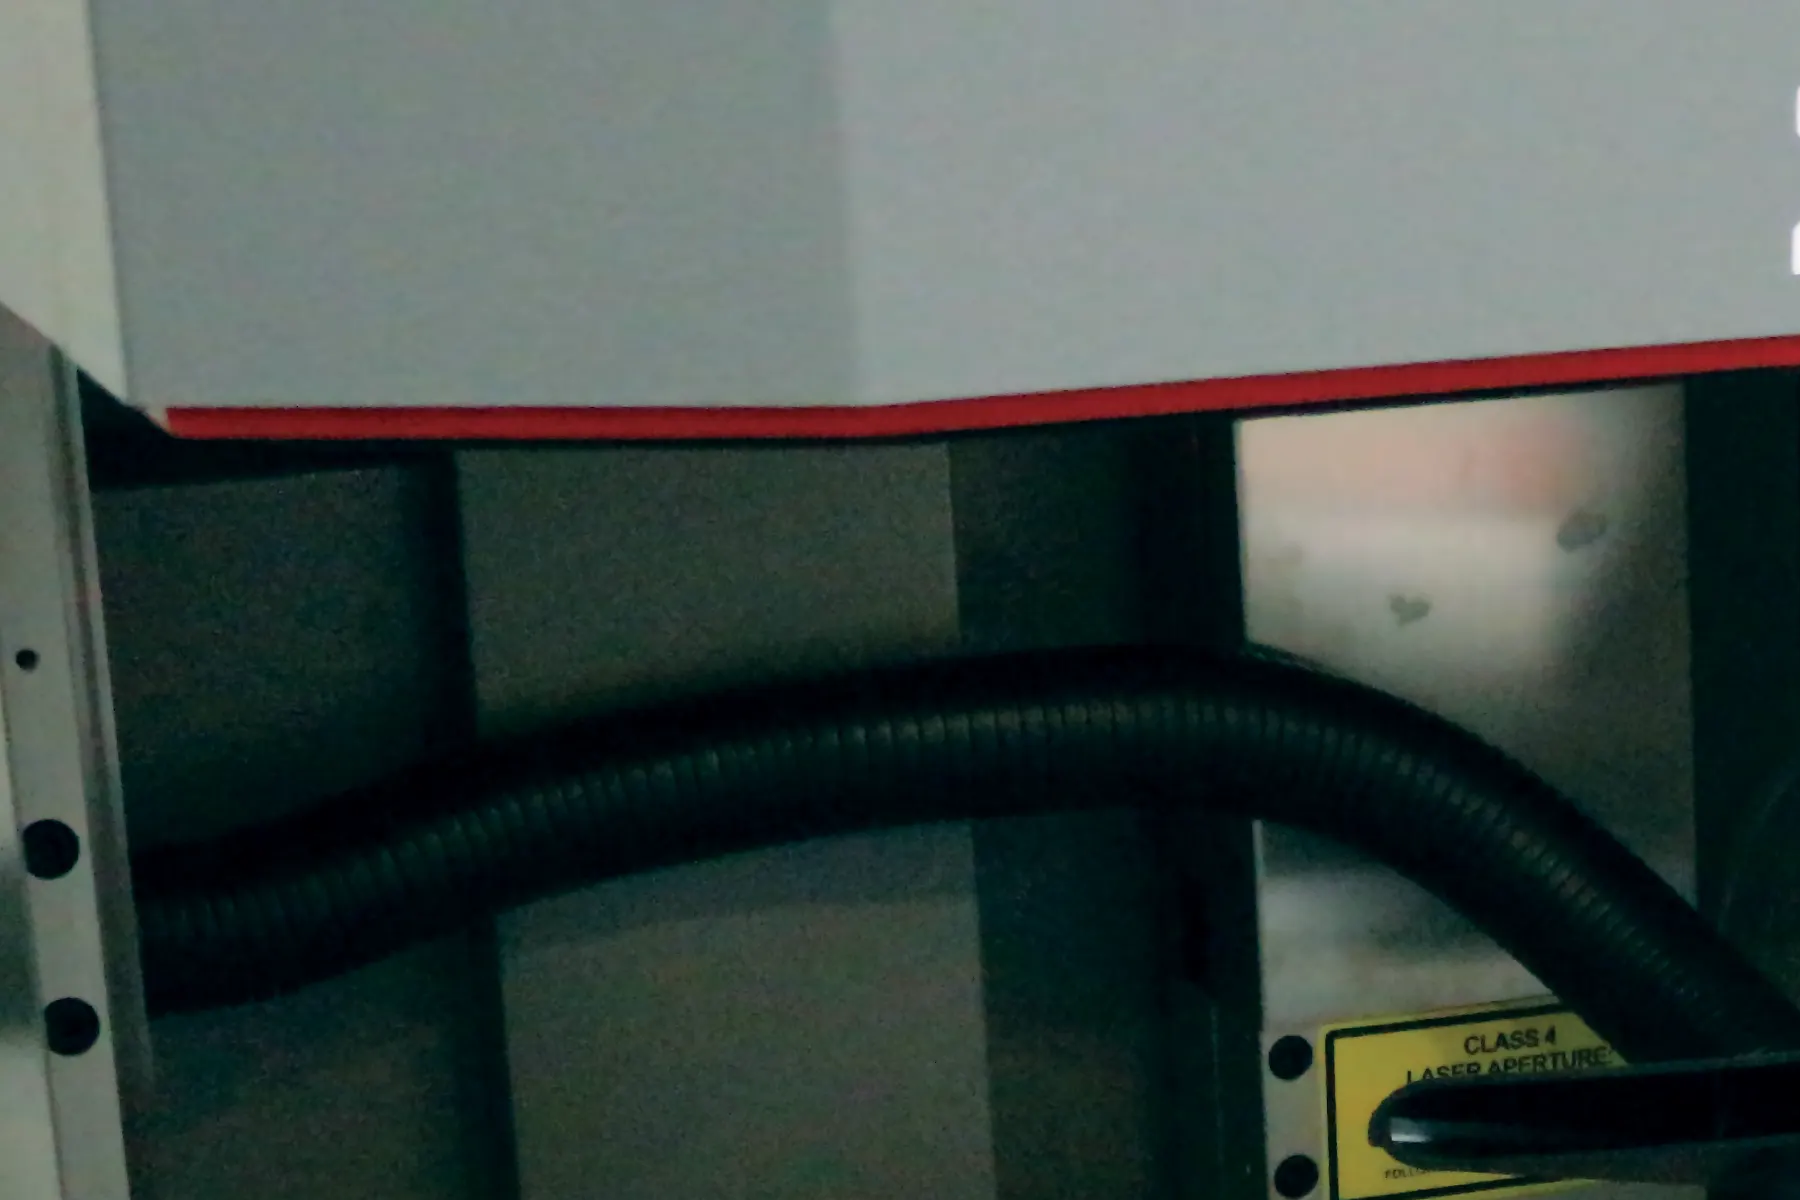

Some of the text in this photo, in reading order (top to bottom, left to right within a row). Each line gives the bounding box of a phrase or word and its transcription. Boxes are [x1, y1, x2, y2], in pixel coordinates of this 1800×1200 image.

[1463, 1023, 1557, 1056] CLASS 4
[1488, 1045, 1611, 1075] APERTURE
